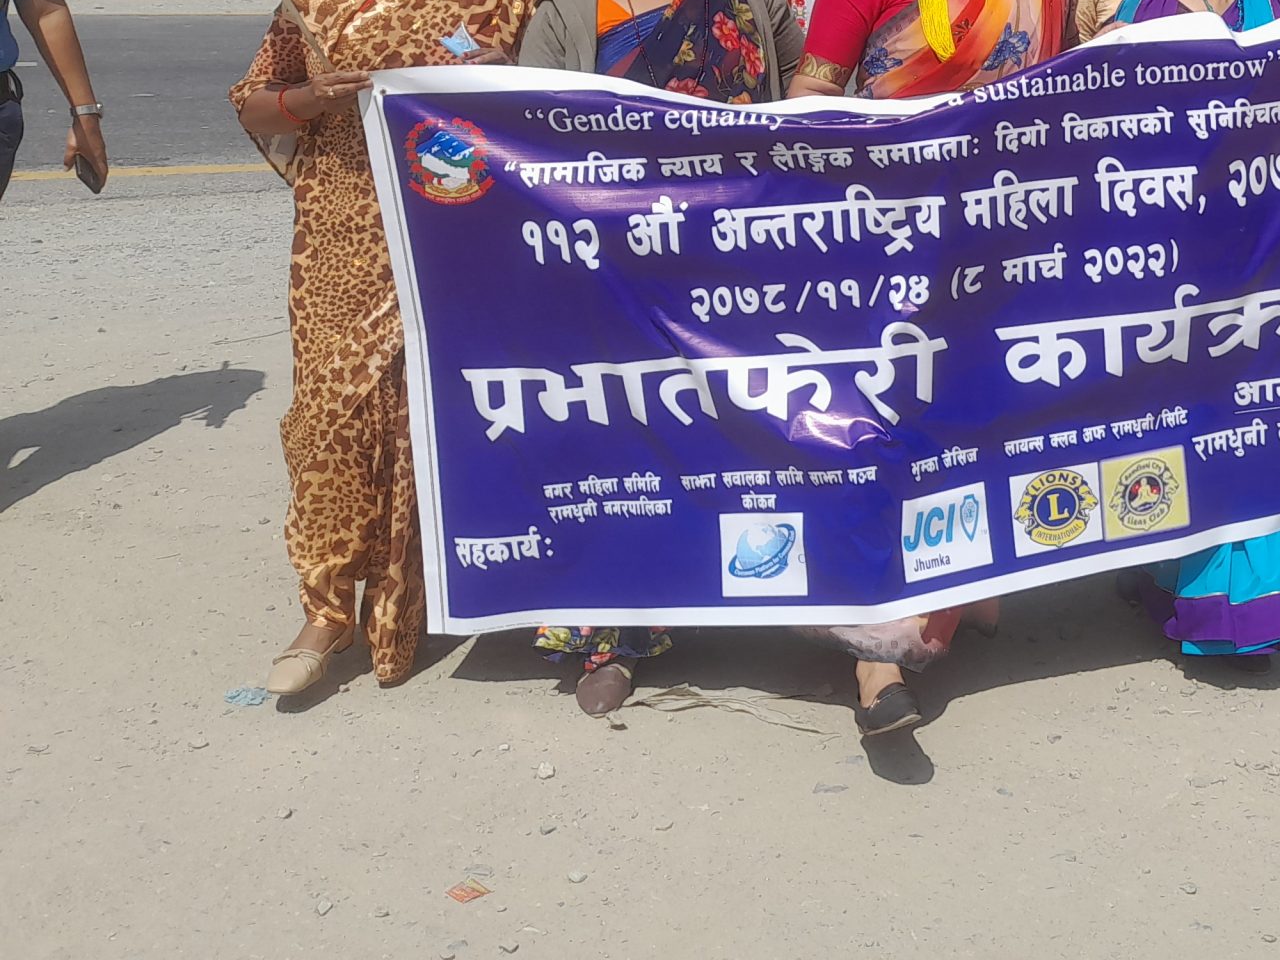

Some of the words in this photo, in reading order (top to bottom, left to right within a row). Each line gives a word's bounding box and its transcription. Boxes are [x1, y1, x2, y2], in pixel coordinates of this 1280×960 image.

[974, 62, 1126, 104] sustainable
[659, 154, 722, 179] न्याय
[735, 152, 758, 176] र
[995, 117, 1050, 154] दिगो
[1062, 105, 1174, 143] विकासको
[521, 217, 601, 270] ११२
[961, 169, 1079, 231] महिला
[1002, 243, 1068, 286] मार्च
[460, 321, 949, 442] प्रभातफेरी
[1004, 434, 1045, 458] लायन्स
[1192, 417, 1268, 462] रामधुनी
[543, 483, 574, 500] नगर
[578, 474, 618, 497] महिला
[623, 471, 661, 493] समिति
[721, 470, 771, 488] सवालका
[1031, 471, 1079, 493] LIONS
[548, 498, 597, 523] रामधुनी
[603, 496, 673, 517] नगरपालिका
[1047, 494, 1070, 521] L
[902, 502, 955, 552] JCI
[1035, 522, 1083, 542] INTERNATIONAL
[913, 552, 952, 573] Jhumka
